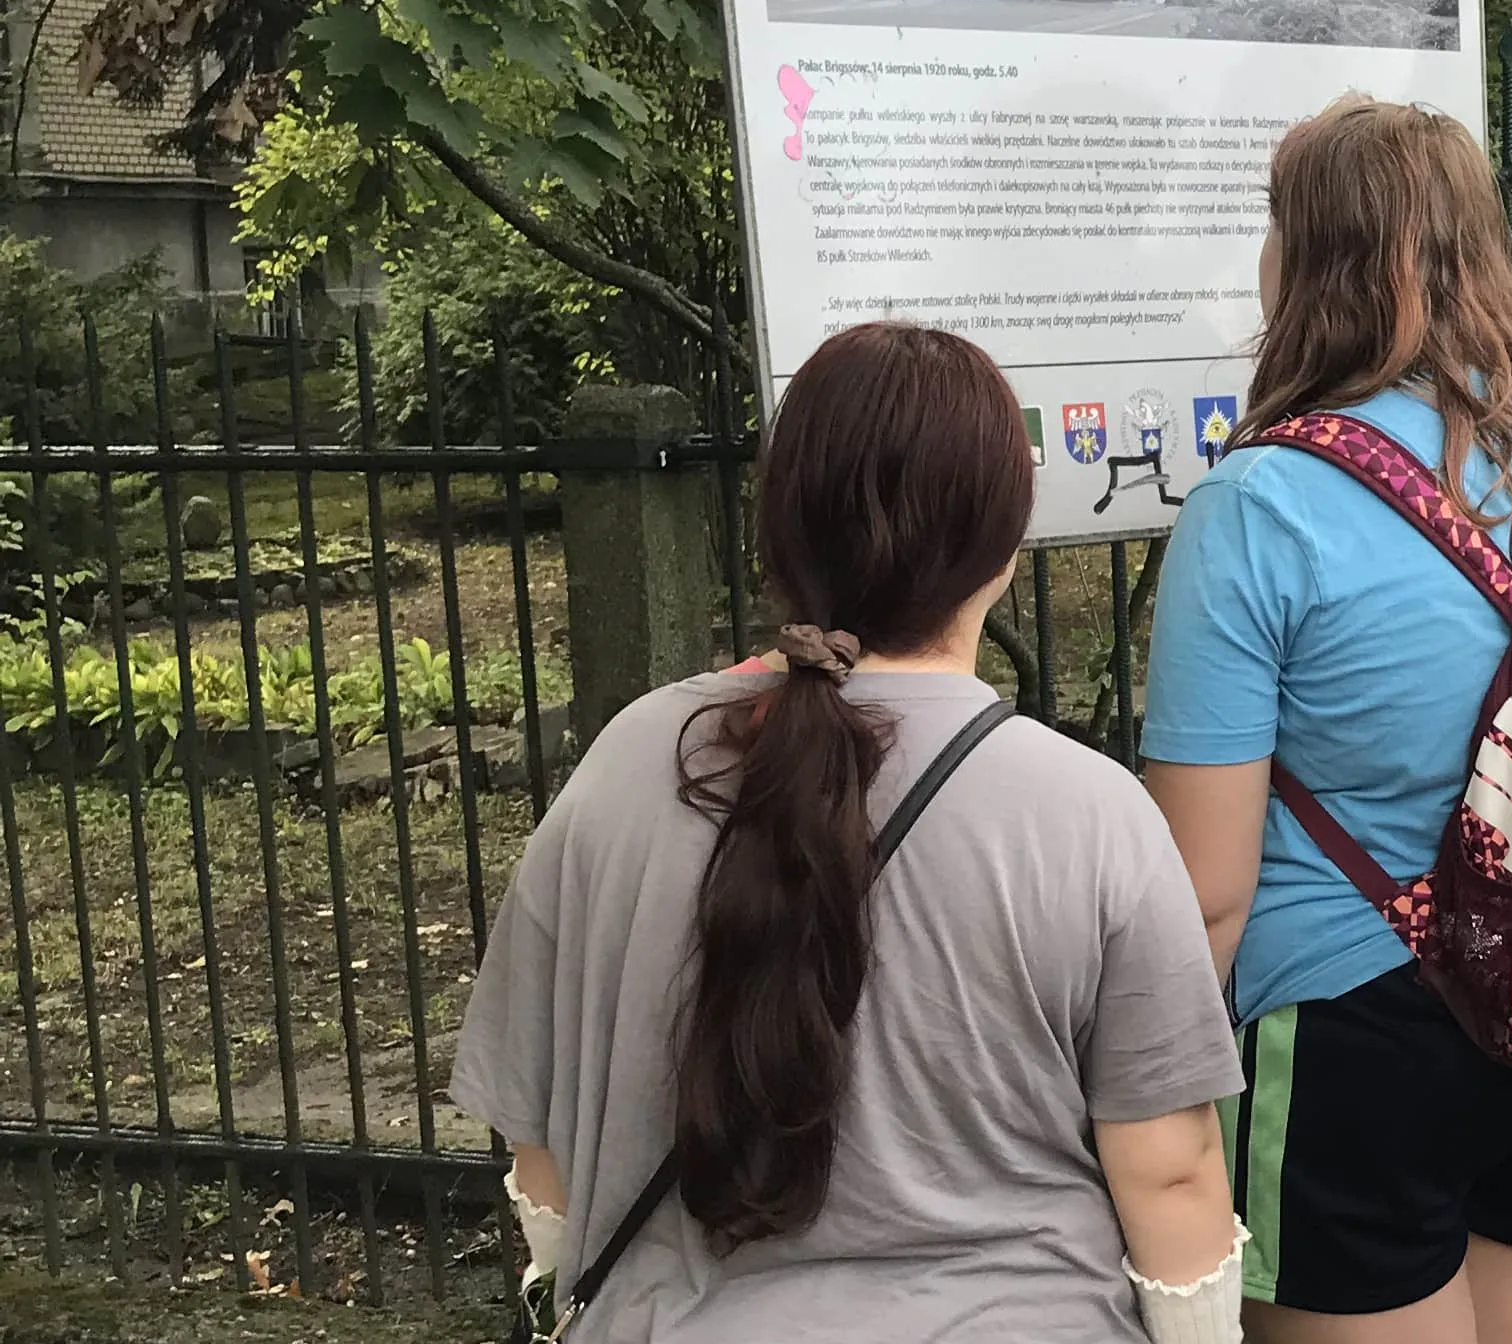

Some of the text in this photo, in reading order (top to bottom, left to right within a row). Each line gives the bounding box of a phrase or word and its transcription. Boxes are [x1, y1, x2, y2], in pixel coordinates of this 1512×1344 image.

[871, 63, 883, 73] 14
[884, 63, 922, 77] sierpnia
[925, 64, 946, 75] 1920
[948, 65, 971, 78] roku,
[972, 65, 996, 79] godz.
[998, 66, 1017, 76] 5.40
[970, 317, 989, 328] 1300
